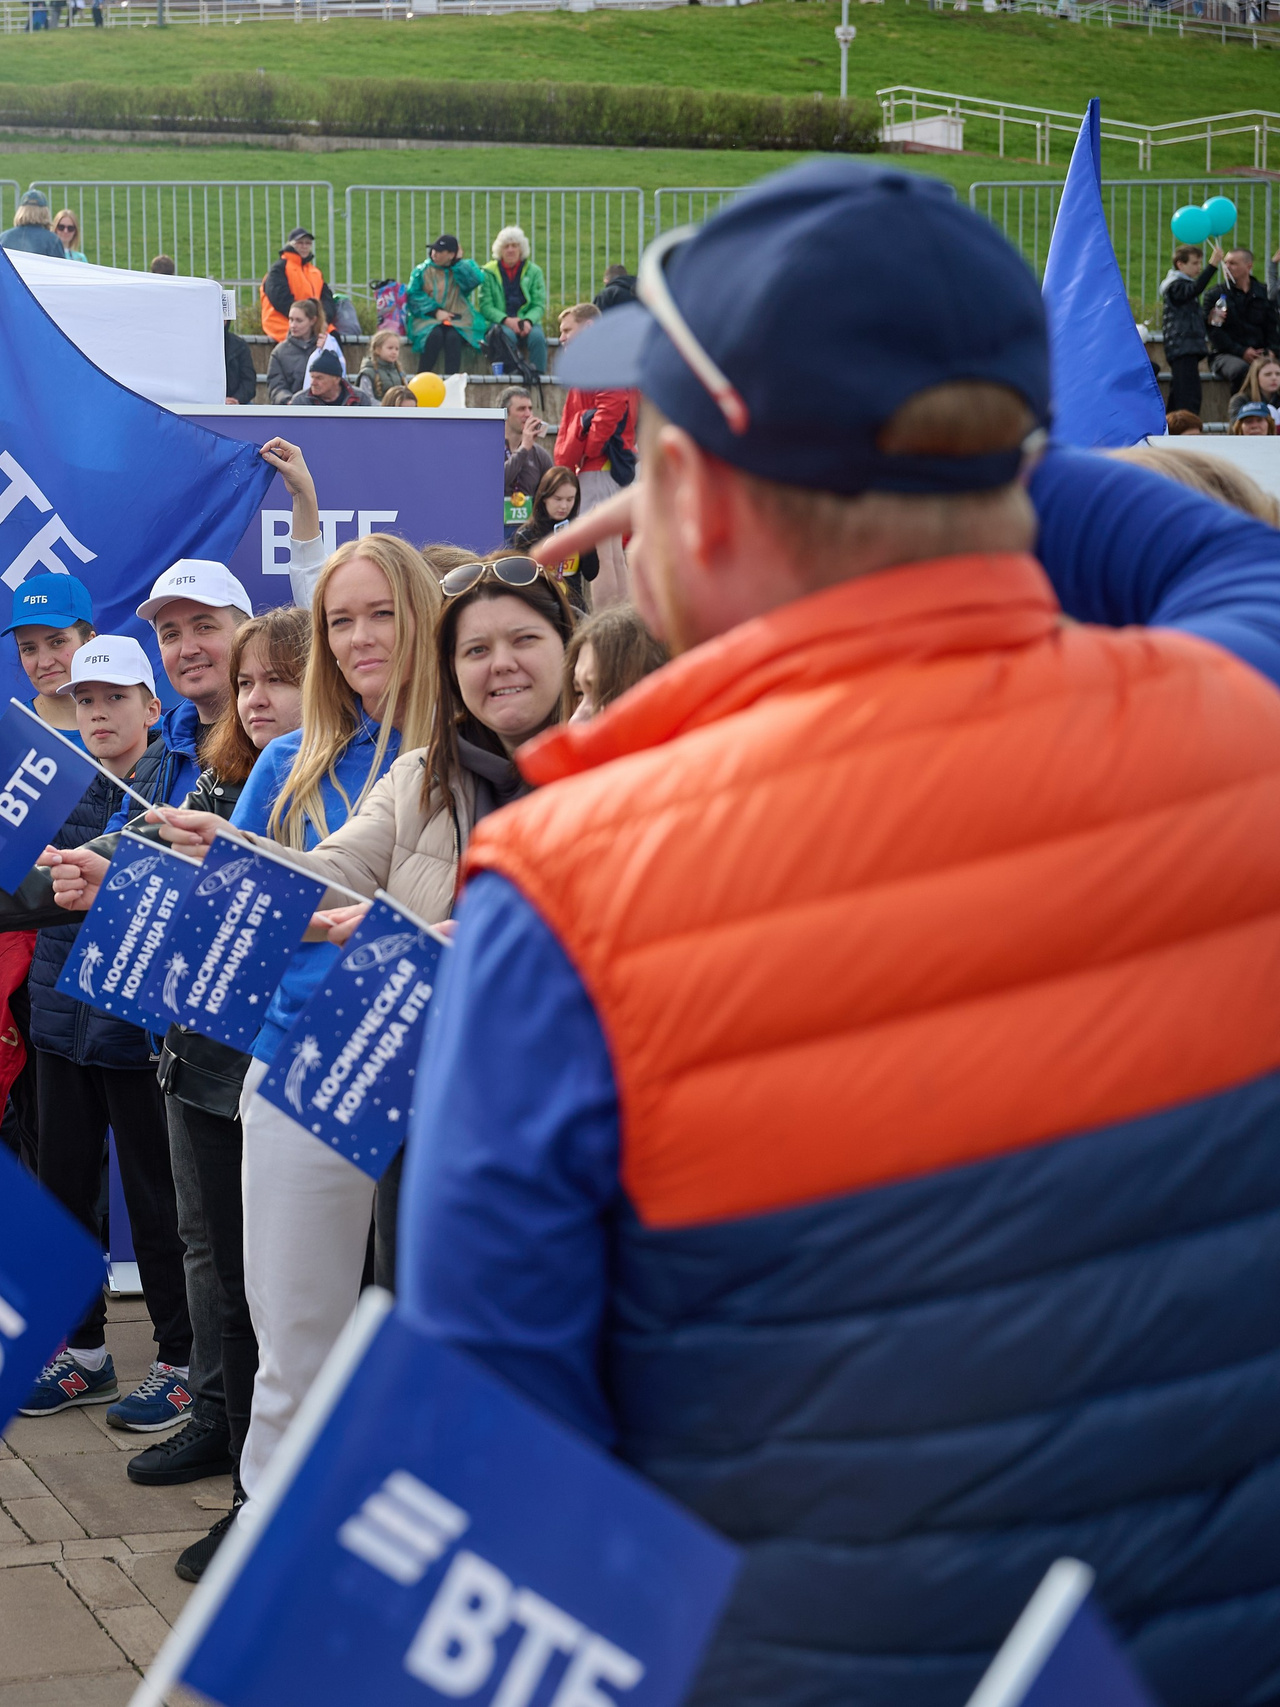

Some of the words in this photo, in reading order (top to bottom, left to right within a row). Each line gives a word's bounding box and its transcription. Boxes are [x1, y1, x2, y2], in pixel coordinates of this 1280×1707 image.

[510, 507, 528, 519] 733
[29, 595, 48, 604] ВТБ
[176, 575, 196, 585] ВТБ
[91, 655, 110, 664] ВТБ
[101, 874, 164, 994] КОСМИЧЕСКАЯ
[120, 919, 167, 1000] КОМАНДА
[156, 888, 180, 921] ВТБ
[185, 877, 257, 1008] КОСМИЧЕСКАЯ
[204, 928, 257, 1015] КОМАНДА
[246, 892, 272, 927] ВТБ
[311, 957, 417, 1112] КОСМИЧЕСКАЯ
[333, 1021, 410, 1125] КОМАНДА
[398, 980, 433, 1024] ВТБ
[58, 1371, 89, 1399] N
[166, 1384, 193, 1413] N
